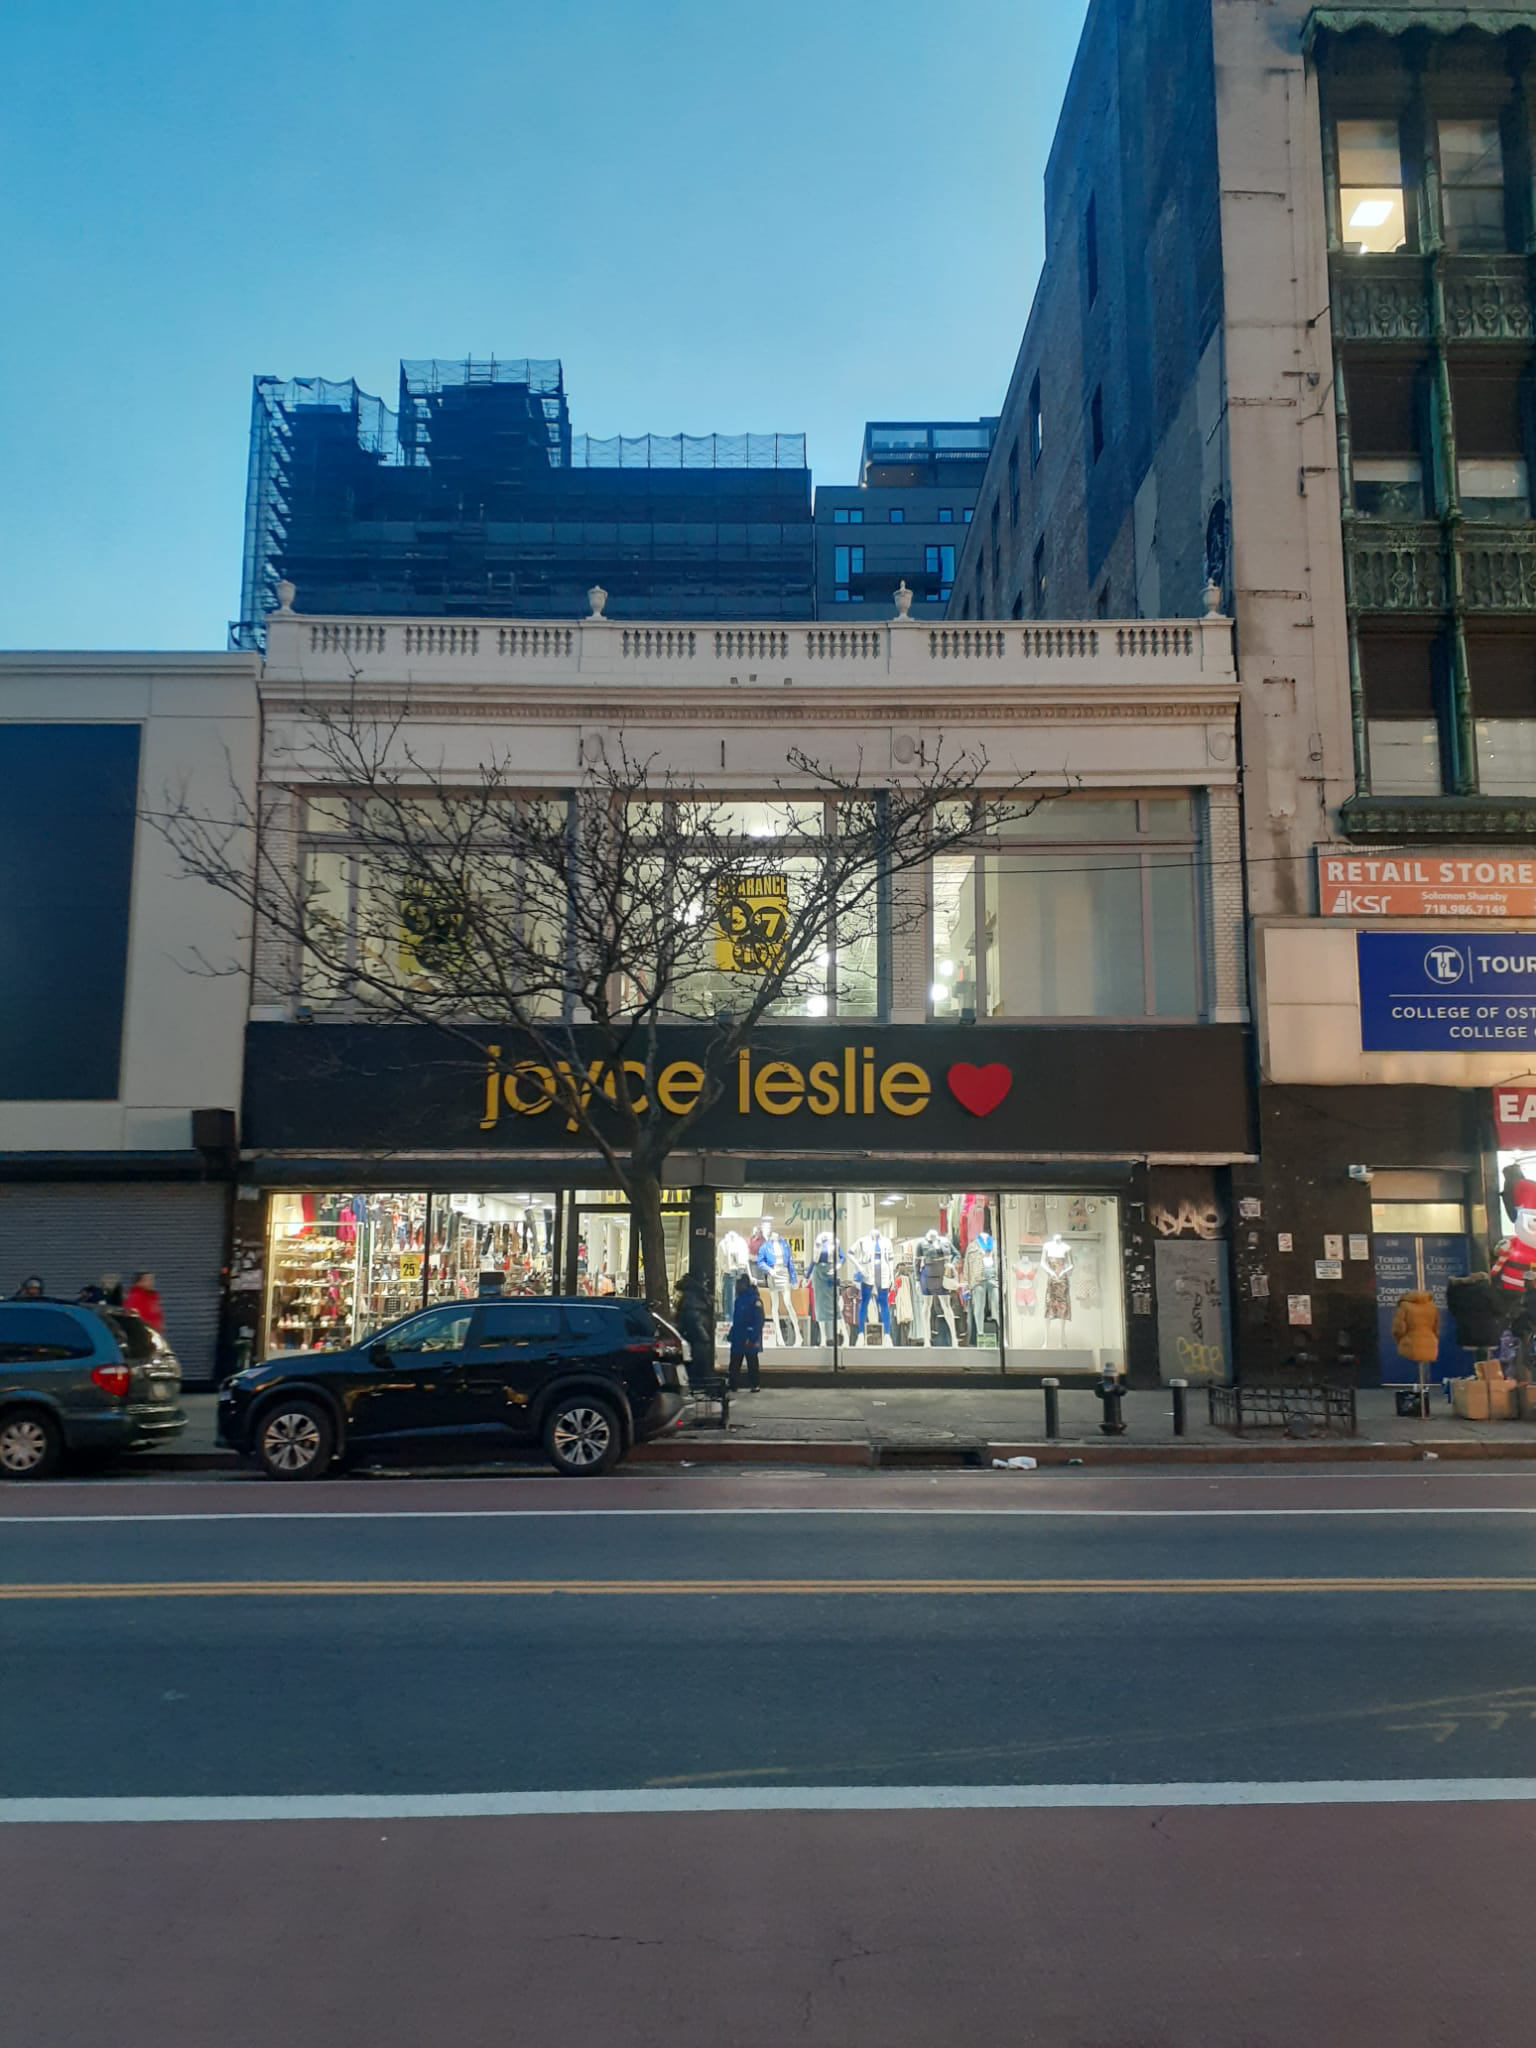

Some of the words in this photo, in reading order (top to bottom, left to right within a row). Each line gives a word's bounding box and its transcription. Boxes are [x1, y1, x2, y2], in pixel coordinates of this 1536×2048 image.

[1328, 862, 1429, 882] RETAIL
[1440, 863, 1533, 883] STORE
[717, 874, 787, 896] ARANCE
[754, 913, 781, 938] $7
[1391, 1006, 1470, 1019] COLLEGE
[1476, 1007, 1499, 1019] OF
[1449, 1026, 1528, 1038] COLLEGE
[480, 1045, 704, 1132] joyce
[738, 1046, 931, 1116] leslie
